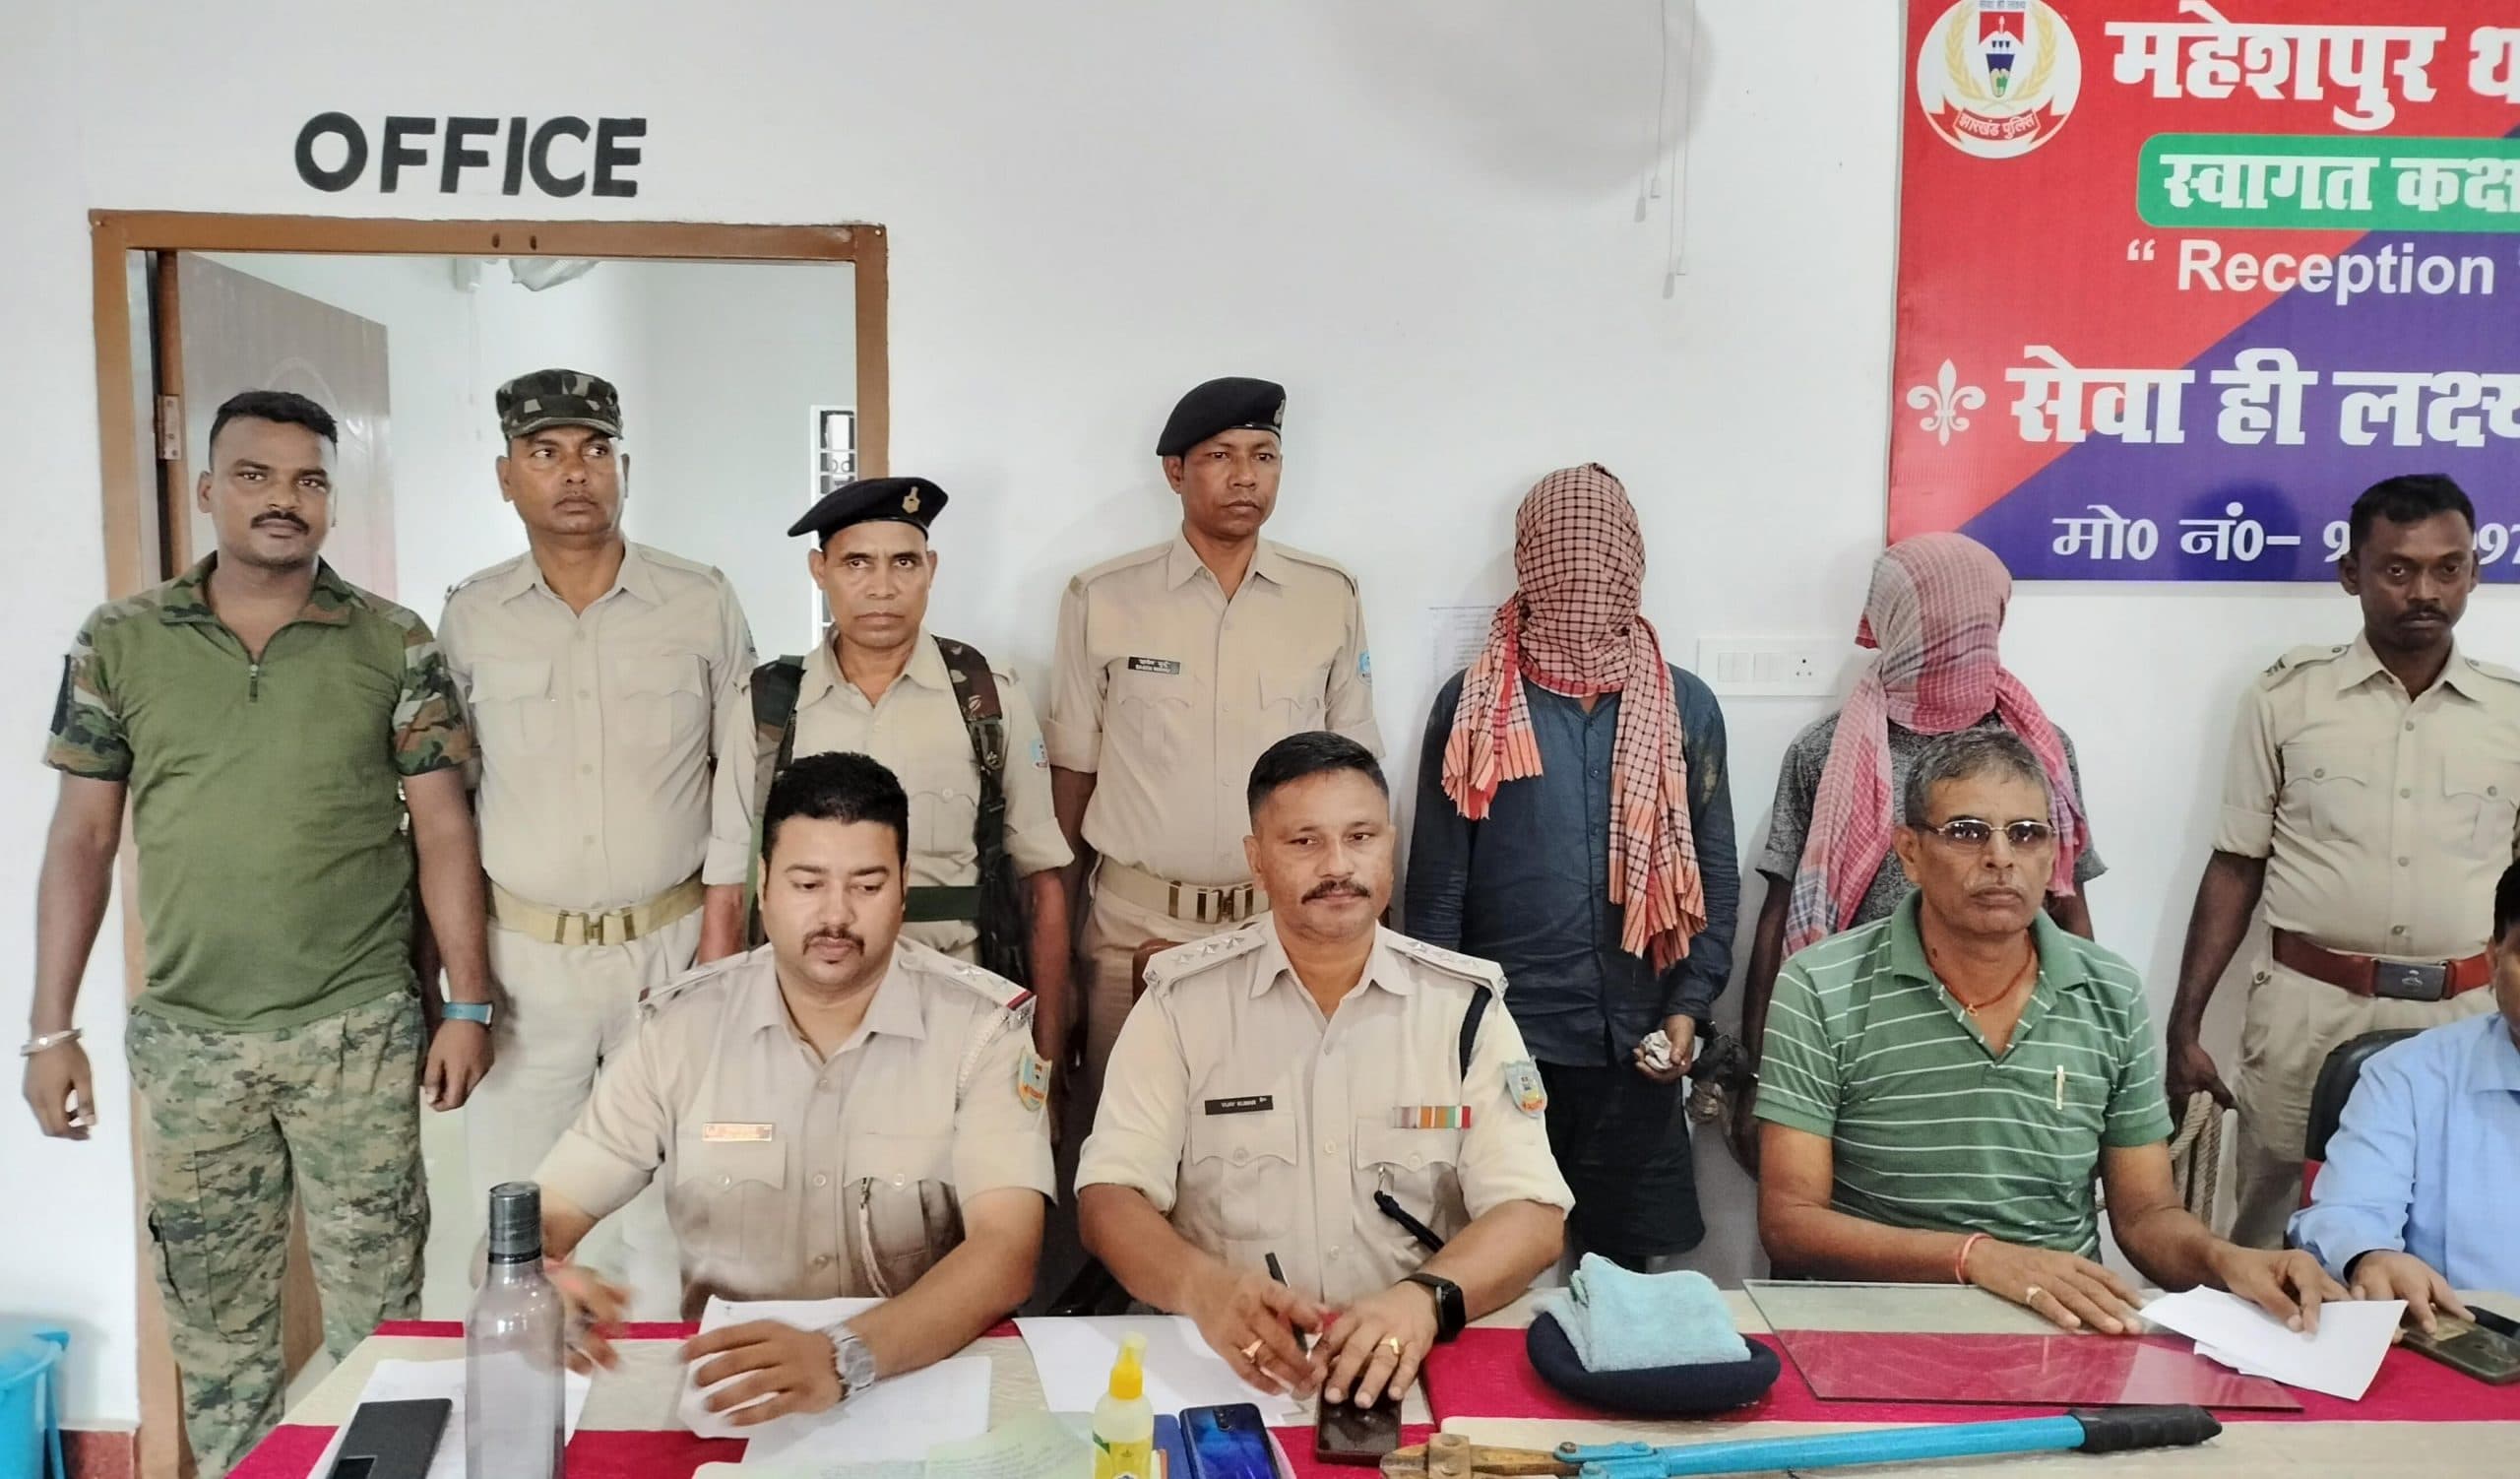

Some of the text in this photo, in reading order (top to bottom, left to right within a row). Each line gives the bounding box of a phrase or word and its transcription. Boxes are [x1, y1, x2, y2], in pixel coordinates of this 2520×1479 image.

[2106, 0, 2447, 131] महेशपुर
[294, 111, 647, 197] OFFICE
[2160, 155, 2380, 210] स्वागत
[2178, 239, 2494, 306] Reception
[2004, 345, 2196, 444] सेवा
[2210, 348, 2319, 445] ही
